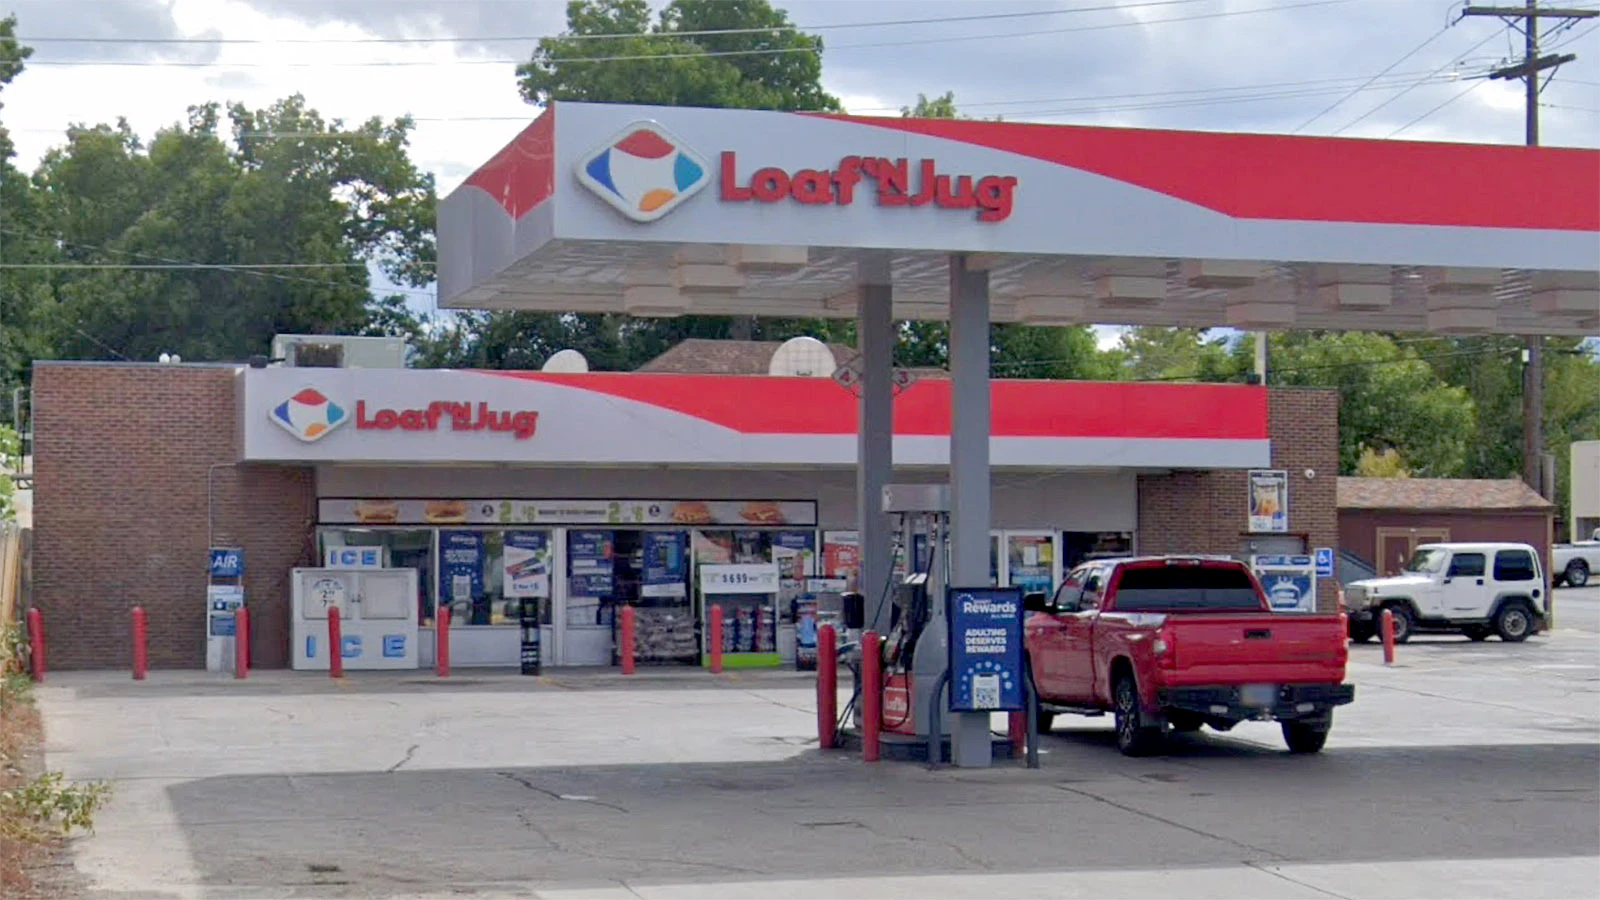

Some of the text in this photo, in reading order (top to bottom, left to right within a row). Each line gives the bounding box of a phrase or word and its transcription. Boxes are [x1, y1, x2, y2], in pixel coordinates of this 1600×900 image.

[212, 554, 238, 569] AIR
[330, 550, 377, 566] ICE
[963, 601, 1016, 613] Rewards
[965, 629, 1006, 637] ADULTING
[306, 635, 407, 658] ICE
[965, 637, 1007, 645] DESERVES
